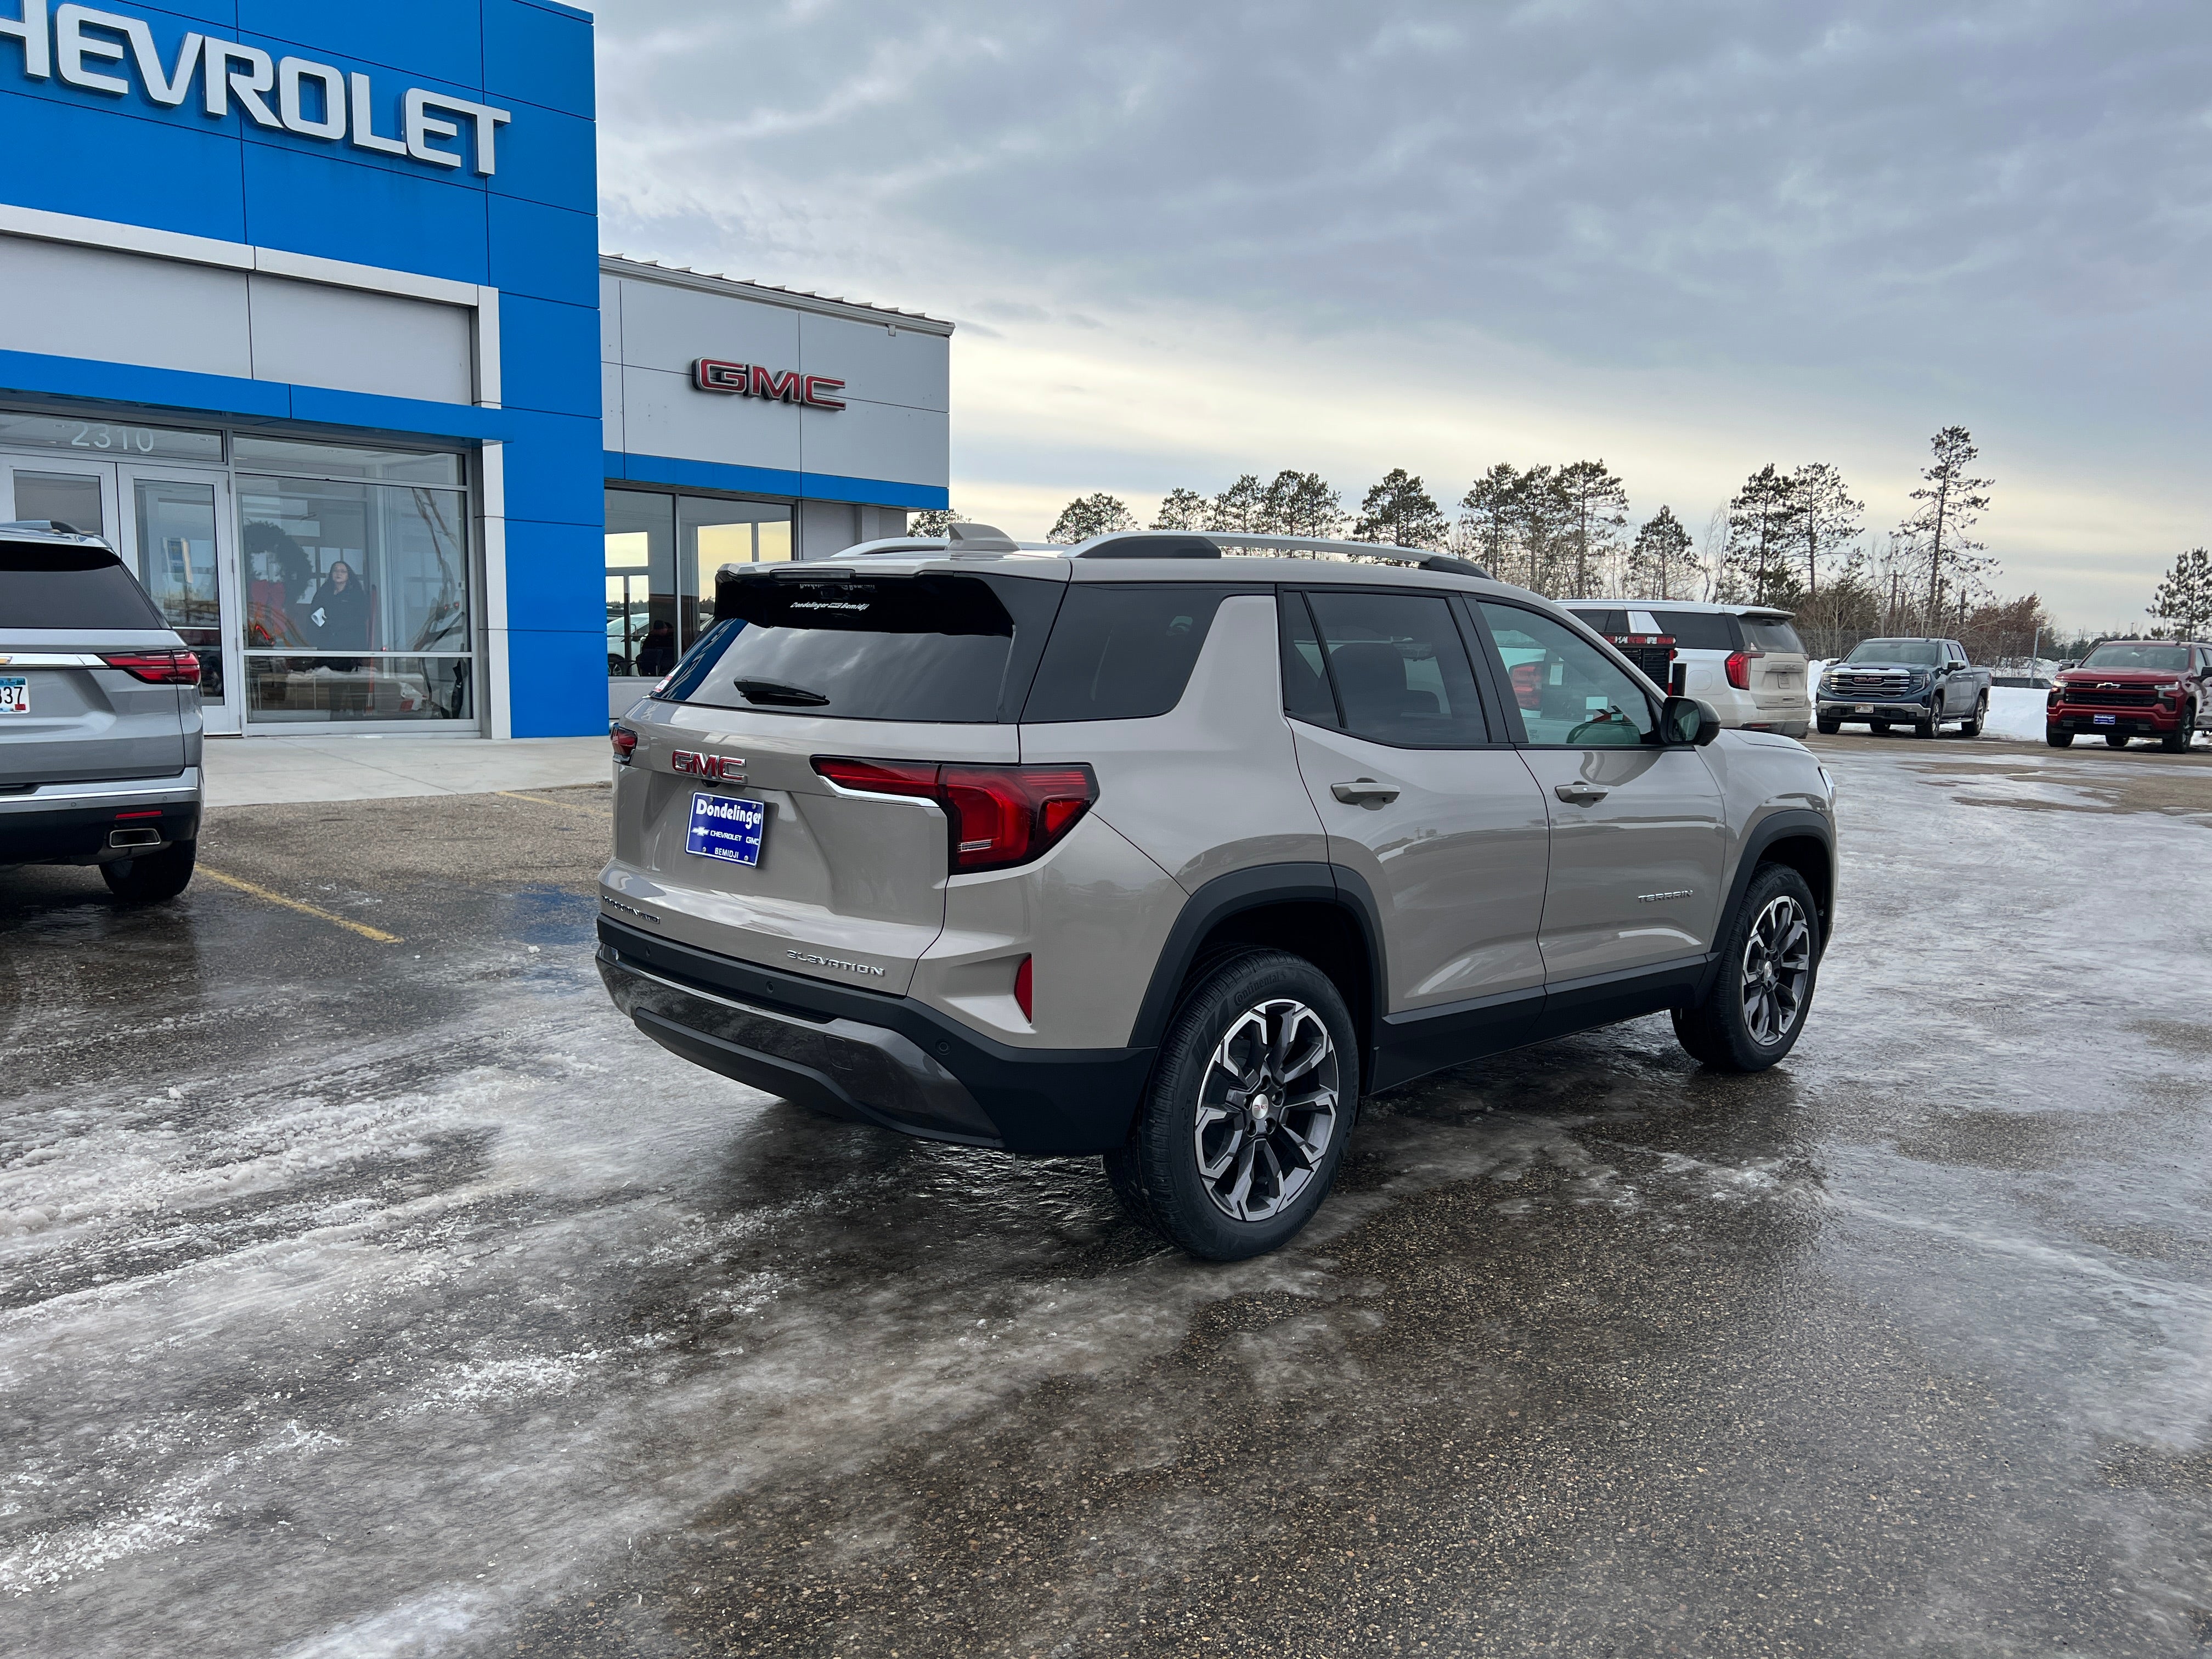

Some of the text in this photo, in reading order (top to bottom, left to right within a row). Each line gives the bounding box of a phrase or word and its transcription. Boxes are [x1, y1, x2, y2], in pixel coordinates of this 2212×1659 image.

[694, 357, 846, 411] GMC
[71, 422, 154, 452] 2310
[0, 686, 23, 704] 37
[673, 749, 747, 783] GMC
[696, 798, 761, 829] Dondelinger
[710, 830, 760, 845] CHEVROLET GMC
[714, 847, 739, 859] BEMIDJI
[1638, 890, 1694, 903] TERRAIN
[787, 950, 885, 977] ELEVATION
[1234, 971, 1279, 1006] Continental
